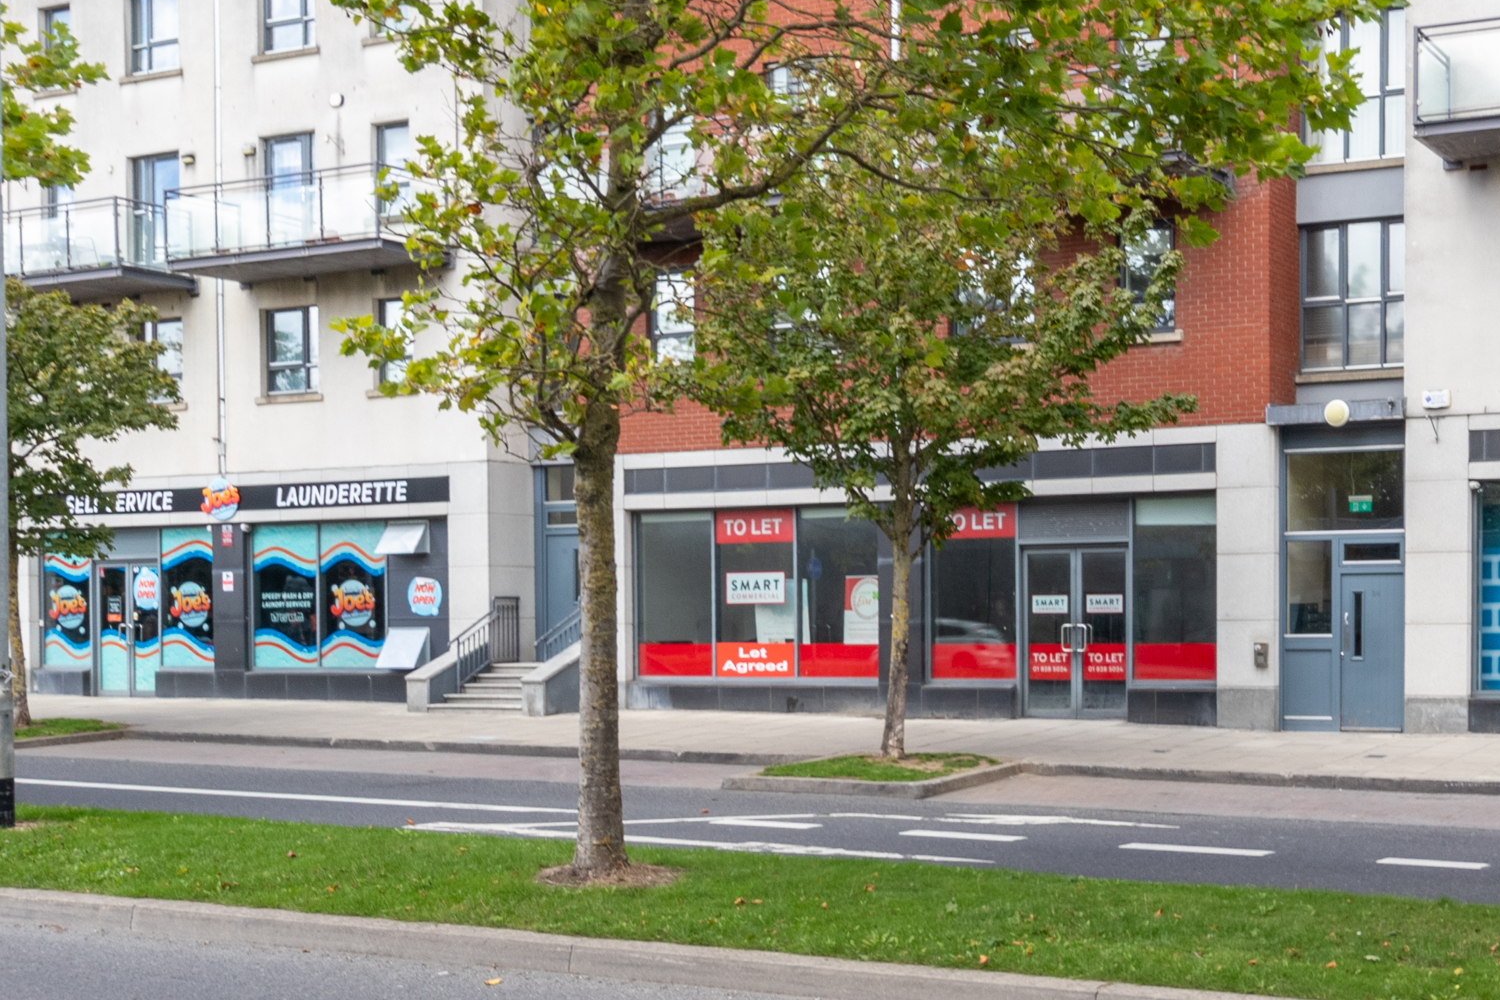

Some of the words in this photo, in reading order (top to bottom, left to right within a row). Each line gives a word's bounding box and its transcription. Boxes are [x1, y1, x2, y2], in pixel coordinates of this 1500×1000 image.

[200, 484, 241, 514] Joe's
[276, 480, 408, 507] LAUNDERETTE
[106, 491, 174, 513] ERVICE
[723, 518, 747, 536] TO
[751, 518, 782, 535] LET
[971, 512, 1006, 531] LET
[138, 580, 156, 589] NOW
[414, 583, 435, 593] NOW
[731, 579, 780, 592] SMART
[137, 590, 156, 599] OPEN
[412, 595, 435, 605] OPEN
[731, 592, 780, 600] COMMERCIAL
[1089, 597, 1120, 605] SMART
[49, 592, 87, 620] Joe's
[170, 590, 211, 618] Joe's
[330, 588, 376, 617] Joe's
[1035, 598, 1066, 606] SMART
[738, 646, 768, 659] Let
[1032, 652, 1048, 663] TO
[1049, 652, 1068, 663] LET
[1087, 652, 1104, 663] TO
[1105, 652, 1124, 663] LET
[722, 660, 788, 674] Agreed
